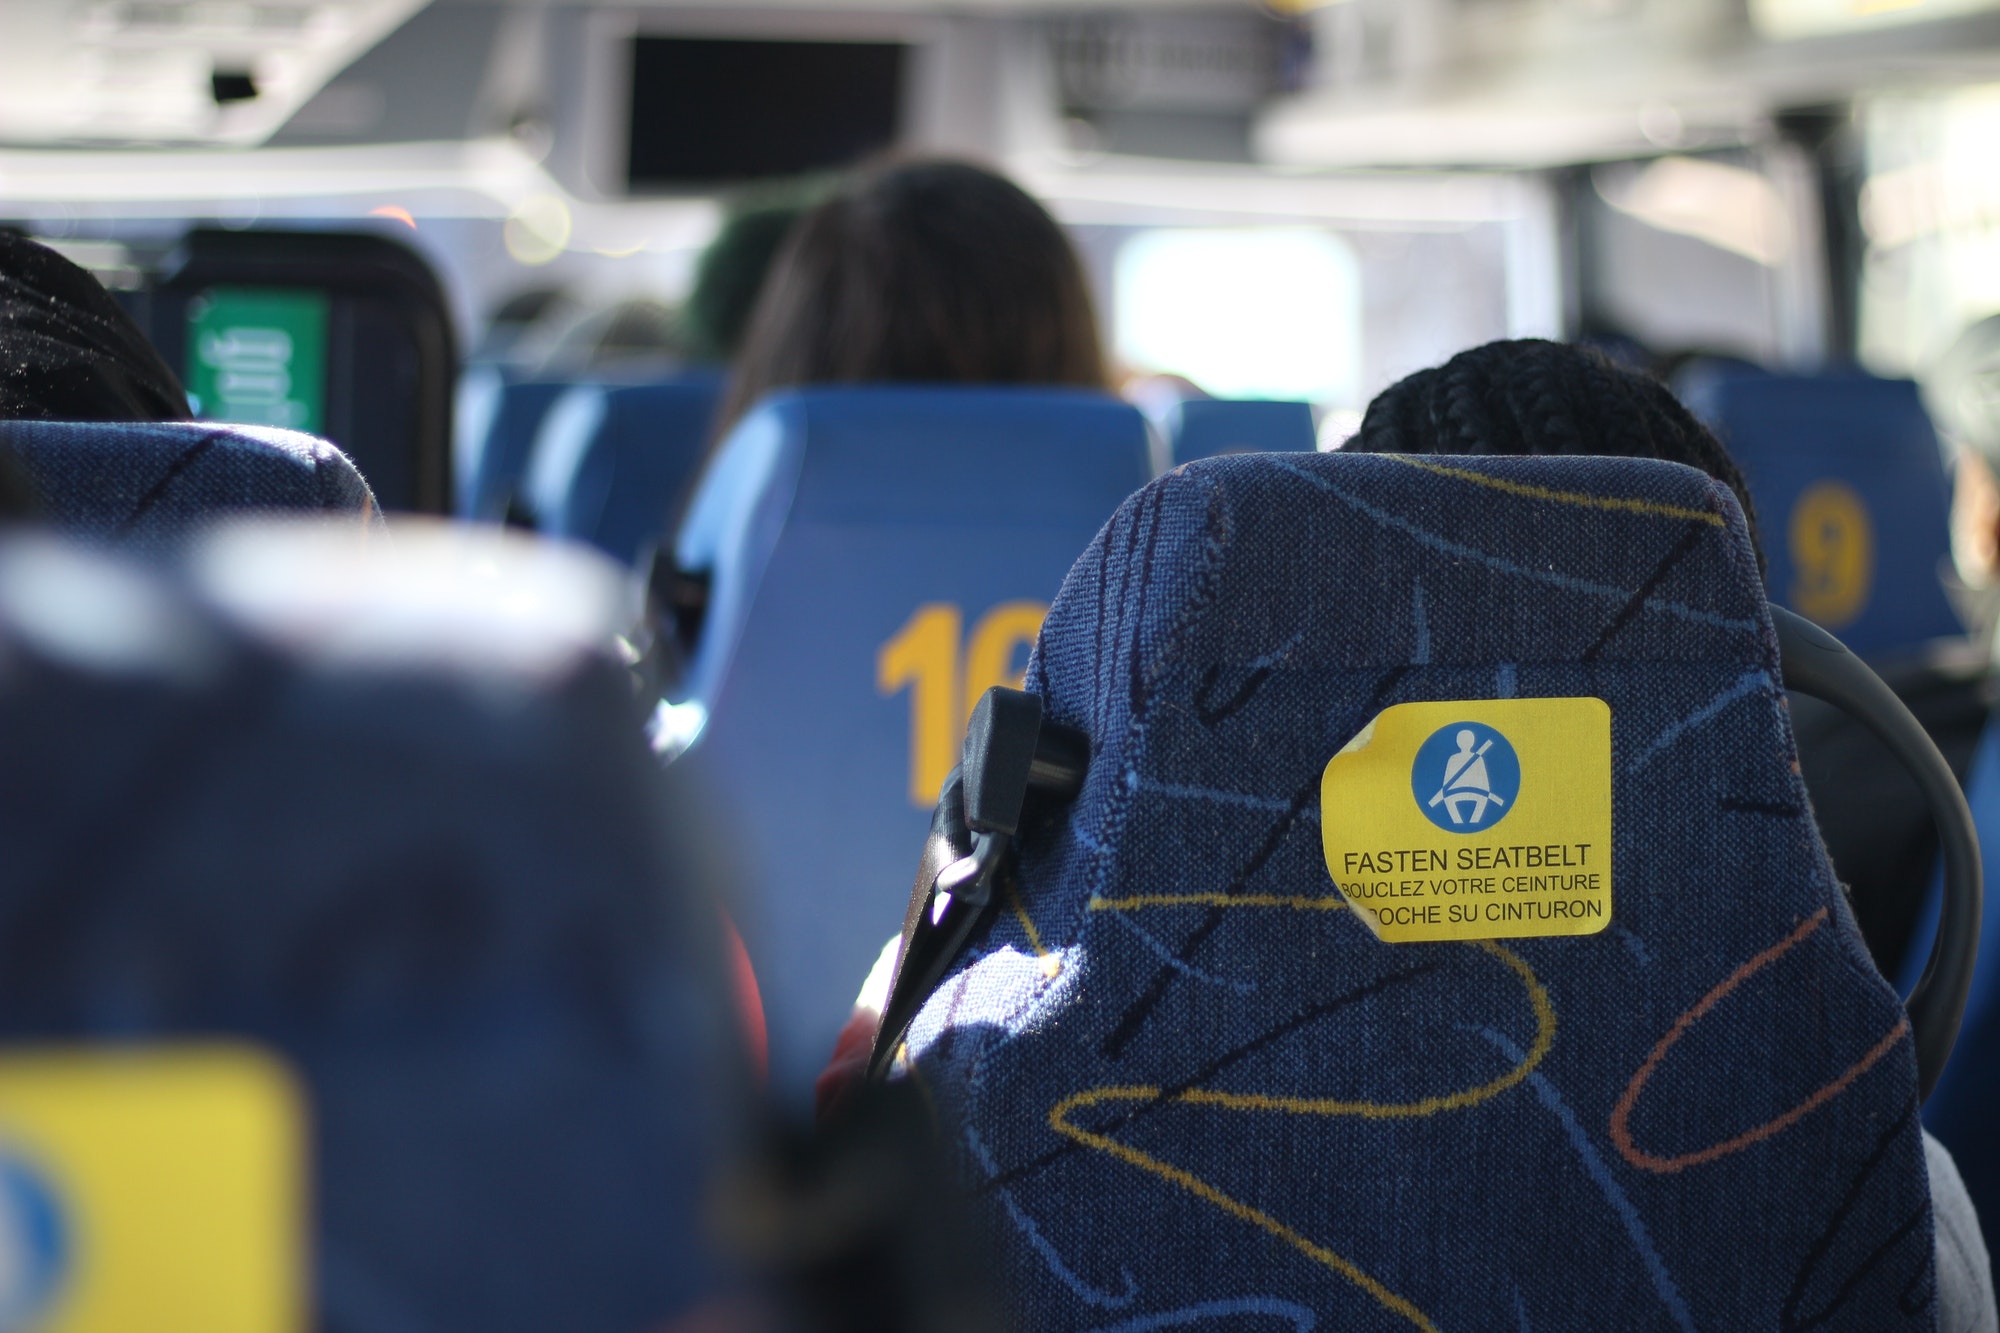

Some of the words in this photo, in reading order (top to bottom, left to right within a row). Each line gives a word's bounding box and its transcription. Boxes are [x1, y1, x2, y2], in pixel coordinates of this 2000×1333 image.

[1789, 481, 1873, 627] 9
[1344, 849, 1447, 875] FASTEN
[1457, 844, 1591, 870] SEATBELT
[1341, 880, 1425, 898] BOUCLEZ
[1430, 878, 1496, 895] VOTRE
[1502, 873, 1600, 893] CEINTURE
[1448, 904, 1478, 922] SU
[1485, 900, 1602, 921] CINTURON
